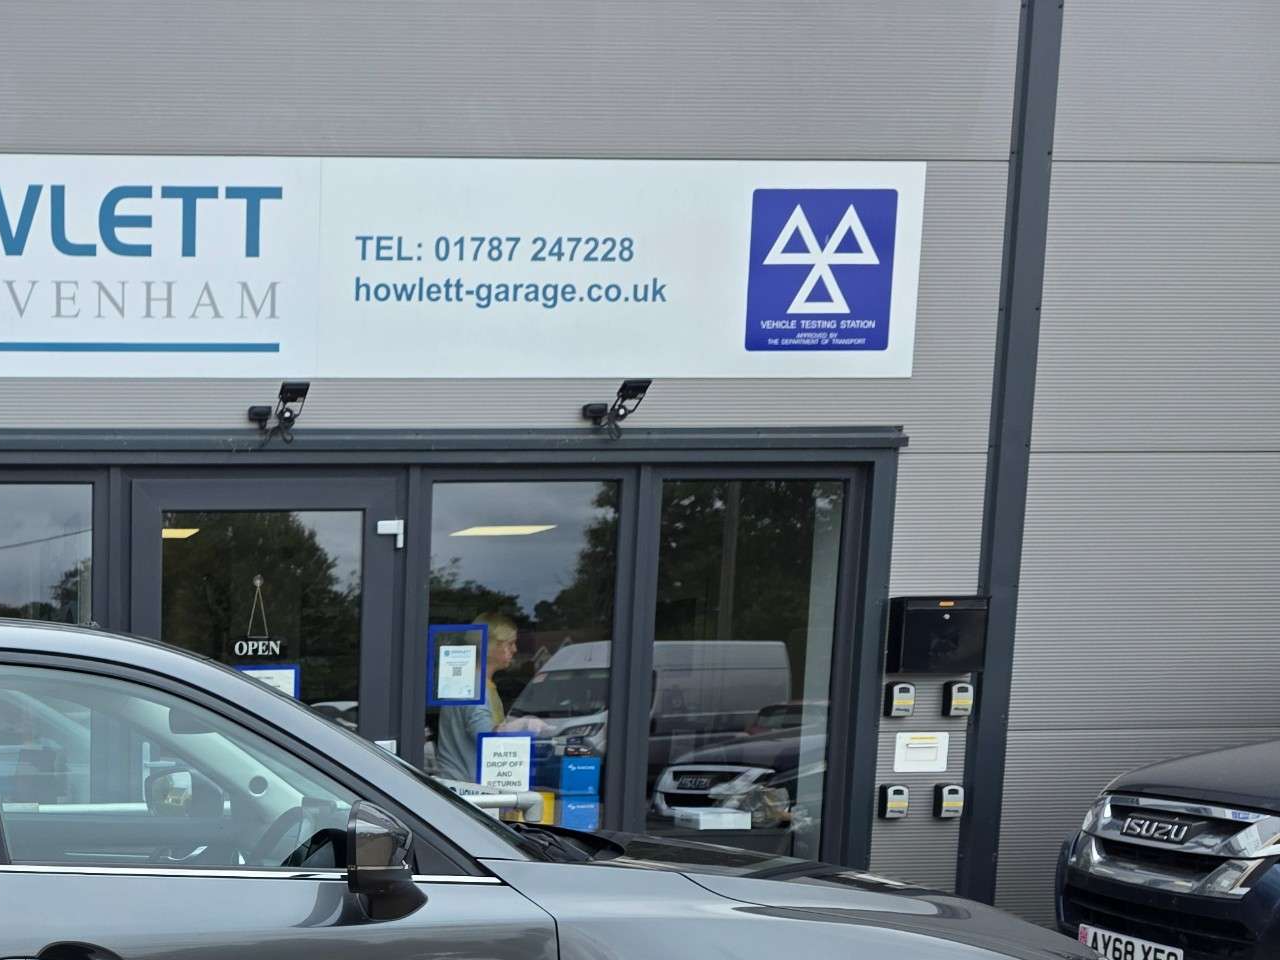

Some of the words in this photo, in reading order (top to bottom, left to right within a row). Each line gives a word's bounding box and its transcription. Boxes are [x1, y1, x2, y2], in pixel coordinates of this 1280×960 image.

[354, 235, 423, 262] TEL:
[434, 236, 521, 262] 01787
[530, 236, 635, 263] 247228
[353, 276, 667, 309] howlett-garage.co.uk
[760, 319, 797, 329] VEHICLE
[800, 319, 837, 329] TESTING
[840, 319, 876, 329] STATION
[234, 640, 281, 656] OPEN
[496, 770, 513, 778] AND
[1122, 816, 1189, 842] ISUZU
